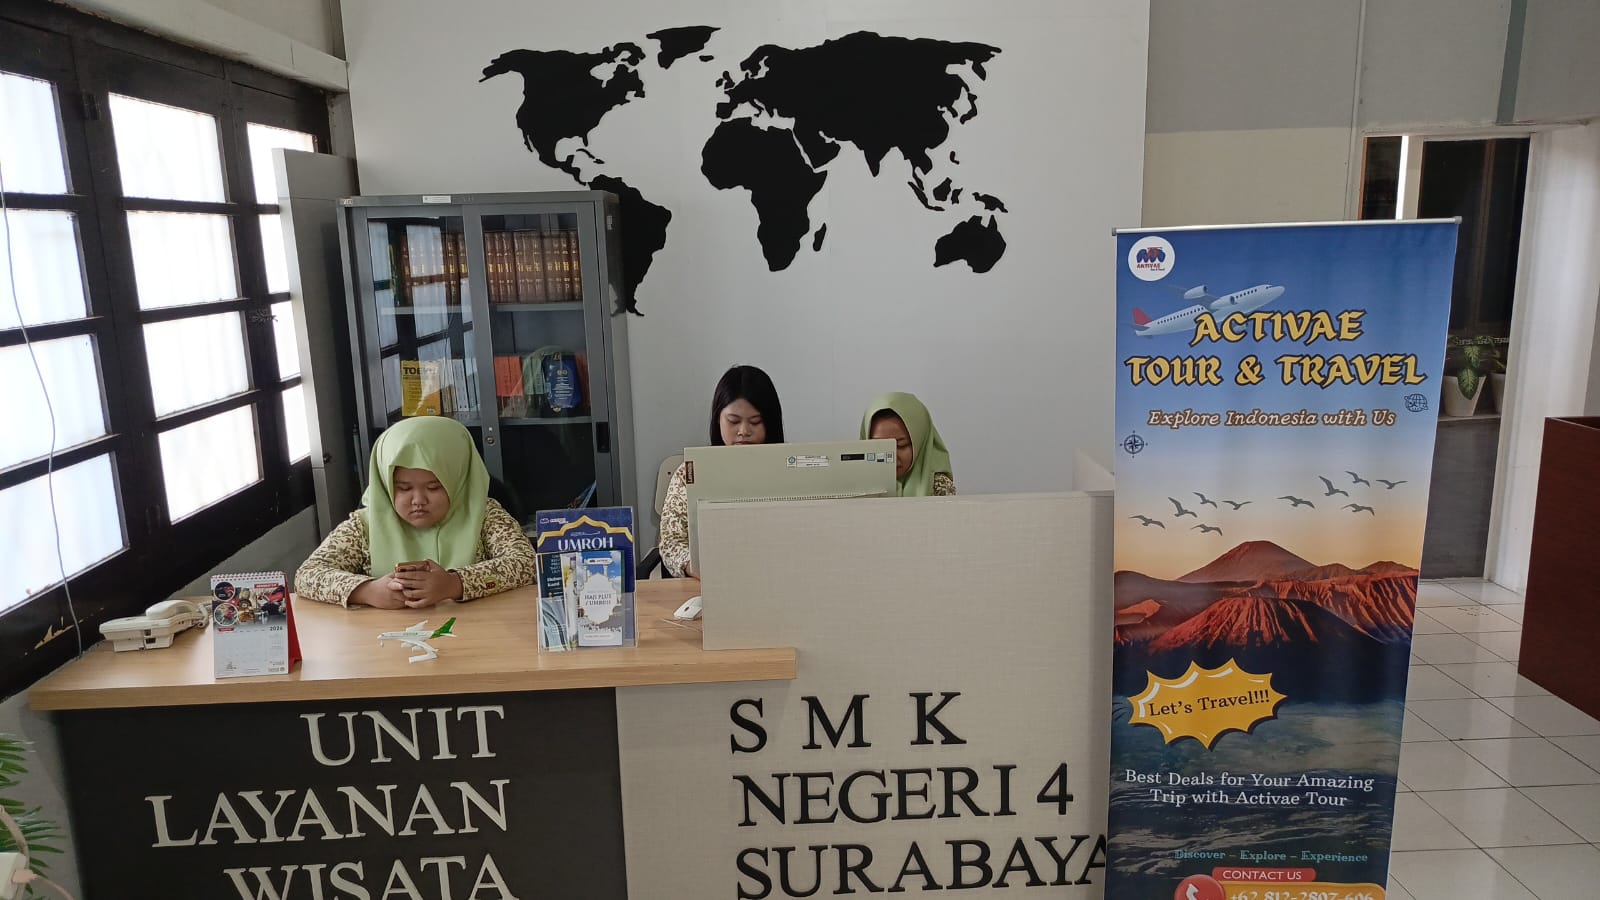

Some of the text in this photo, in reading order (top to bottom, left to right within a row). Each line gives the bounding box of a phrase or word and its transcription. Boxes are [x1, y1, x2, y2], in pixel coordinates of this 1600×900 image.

[1190, 309, 1366, 346] ACTIVAE
[1125, 353, 1427, 388] TOUR & TRAVEL
[1147, 409, 1396, 430] Explore Indonesia with Us
[557, 536, 613, 551] UMROH
[1148, 689, 1271, 716] Let’s Travel!!!
[301, 706, 505, 767] UNIT
[733, 763, 1075, 828] NEGERI 4
[1125, 770, 1375, 791] Best Deals for Your Amazing
[1150, 789, 1348, 806] Trip with Activae Tour
[145, 780, 511, 848] LAYANAN
[736, 835, 1107, 900] SURABAYA
[1174, 850, 1226, 860] Discover
[1240, 850, 1287, 861] Explore
[1301, 851, 1368, 862] Experience
[224, 854, 519, 900] WISATA
[1222, 870, 1302, 881] CONTACT US
